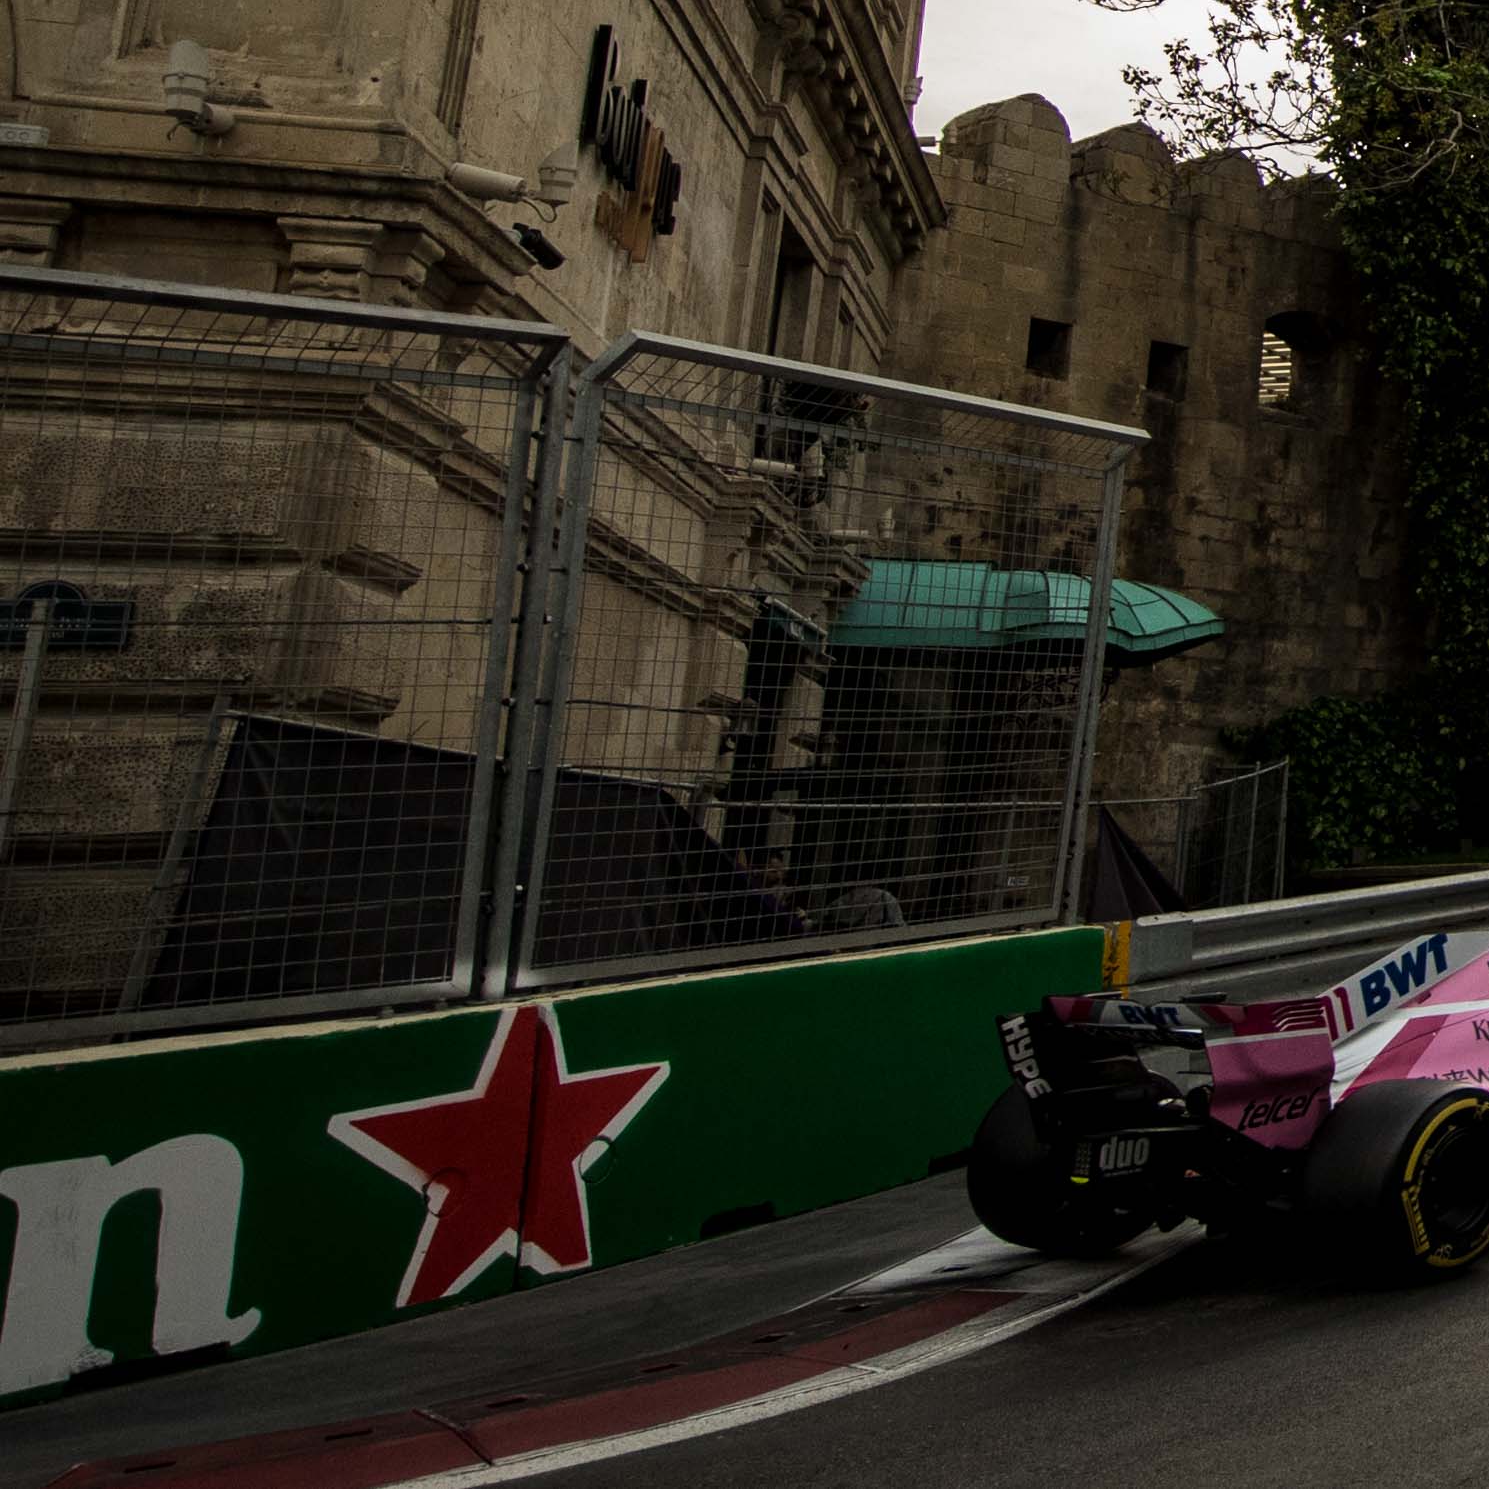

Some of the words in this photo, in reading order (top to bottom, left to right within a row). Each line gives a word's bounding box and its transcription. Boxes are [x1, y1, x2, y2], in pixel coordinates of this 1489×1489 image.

[1359, 932, 1448, 1018] BWT
[1117, 1004, 1180, 1025] BWT
[1000, 1014, 1053, 1100] HYPE
[1238, 1086, 1321, 1130] telcel
[1099, 1135, 1150, 1171] duo
